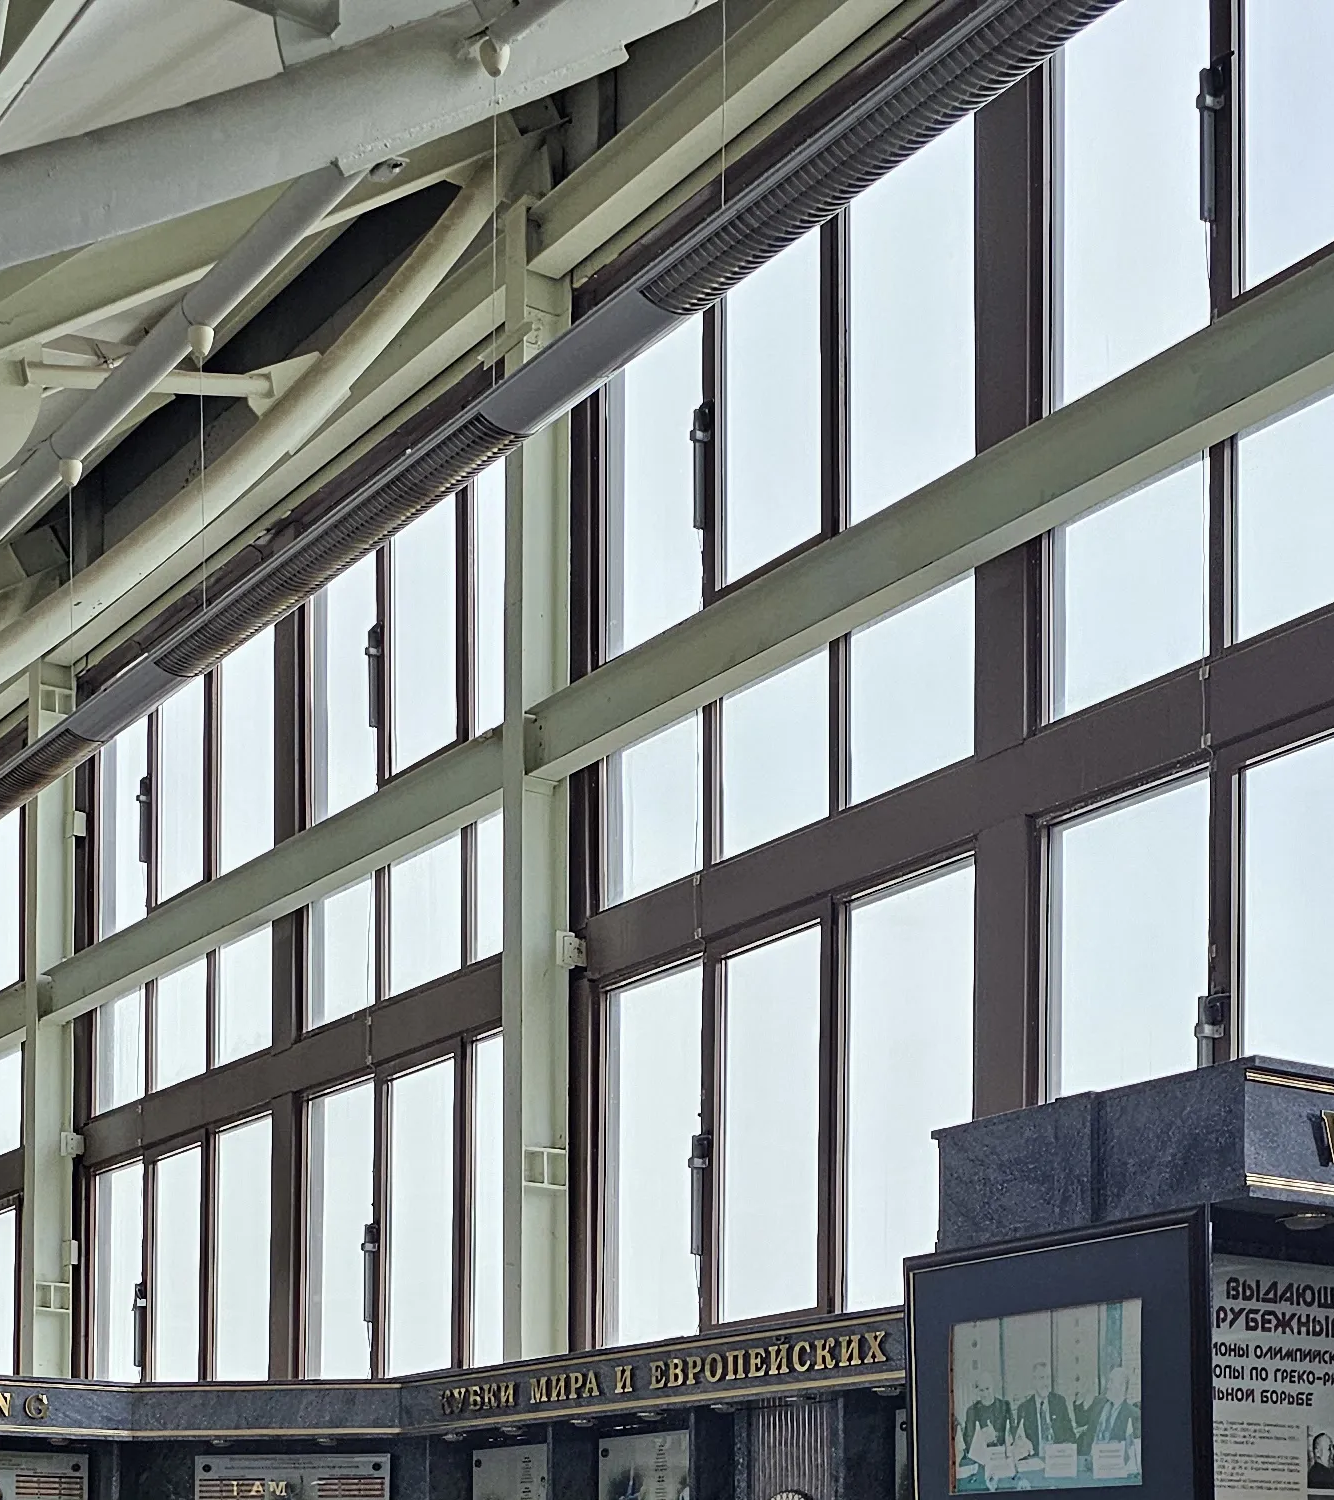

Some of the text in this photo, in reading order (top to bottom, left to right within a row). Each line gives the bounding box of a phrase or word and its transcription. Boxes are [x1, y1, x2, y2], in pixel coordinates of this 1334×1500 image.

[530, 1370, 599, 1404] МИРА
[615, 1365, 632, 1393] И
[650, 1331, 887, 1389] ЕВРОПЕЙСКИХ
[1249, 1366, 1268, 1381] ПО
[1260, 1390, 1314, 1407] БОРЬБЕ
